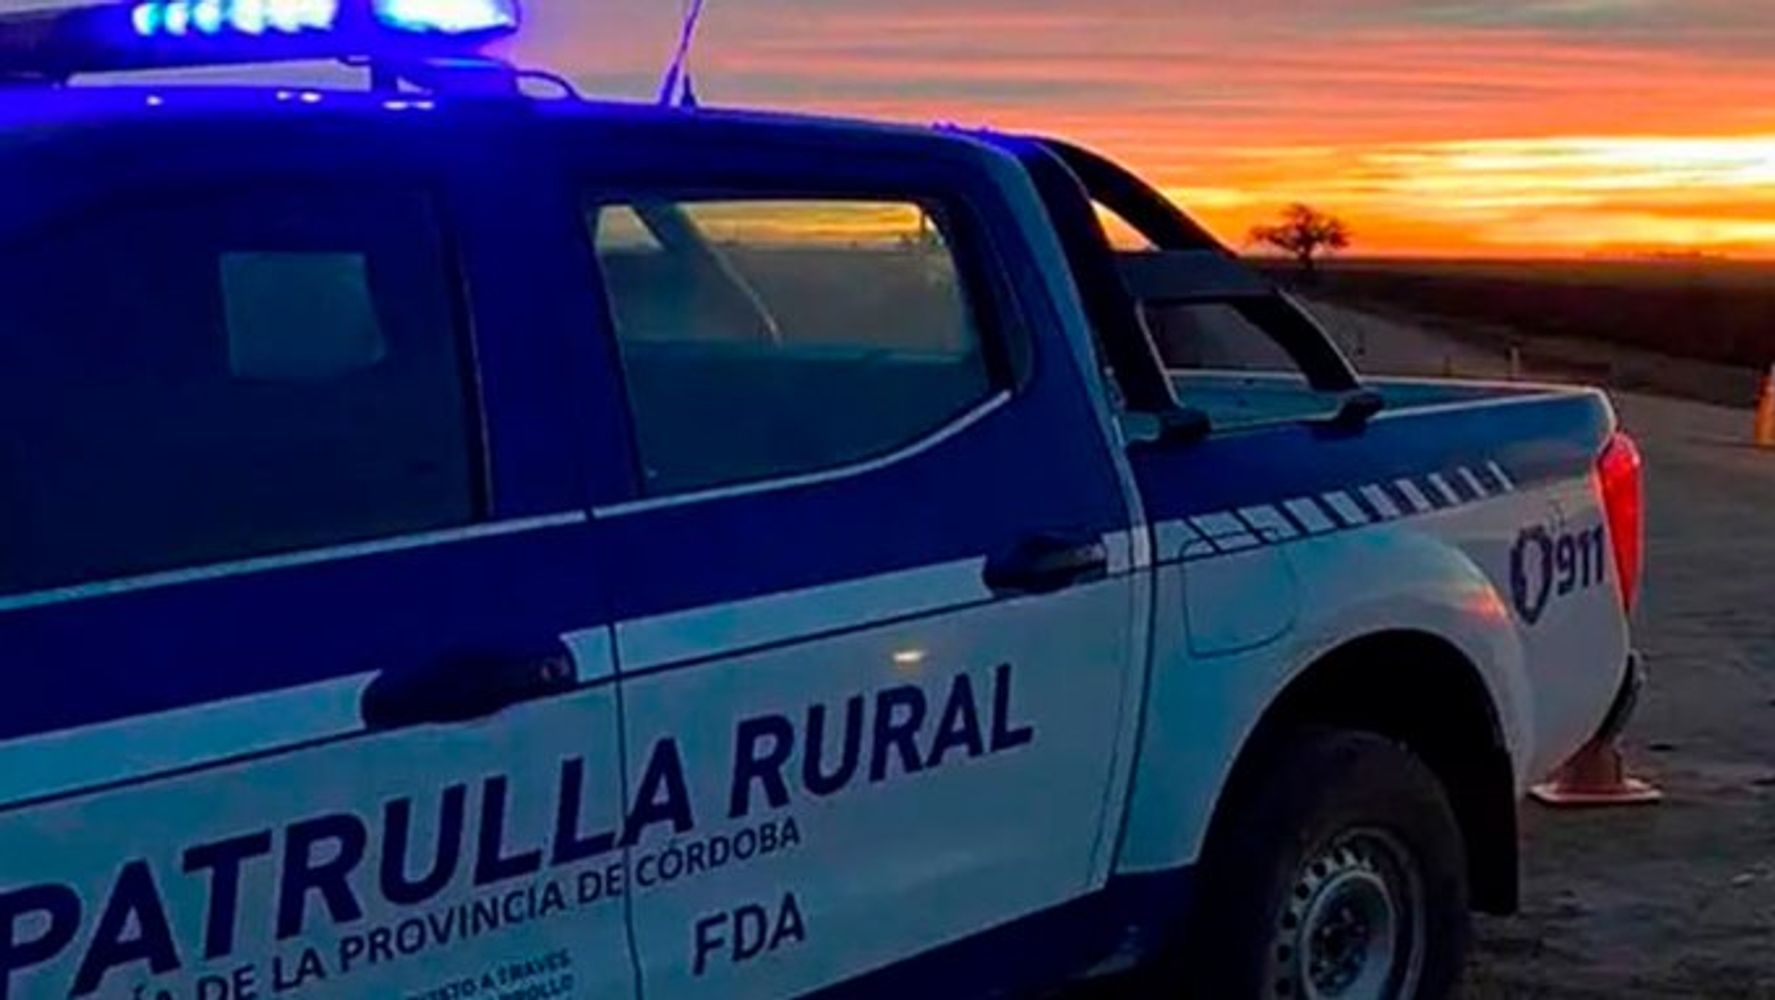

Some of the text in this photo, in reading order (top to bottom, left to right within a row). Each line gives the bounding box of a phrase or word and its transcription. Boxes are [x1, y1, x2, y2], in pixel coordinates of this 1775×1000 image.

[1556, 523, 1604, 597] 911
[0, 663, 1034, 1000] PATRULLA RURAL
[197, 964, 257, 1000] DE
[271, 948, 326, 990] LA
[338, 879, 566, 974] PROVINCIA
[576, 863, 625, 904] DE
[635, 816, 800, 888] CÓRDOBA
[691, 892, 805, 977] FDA
